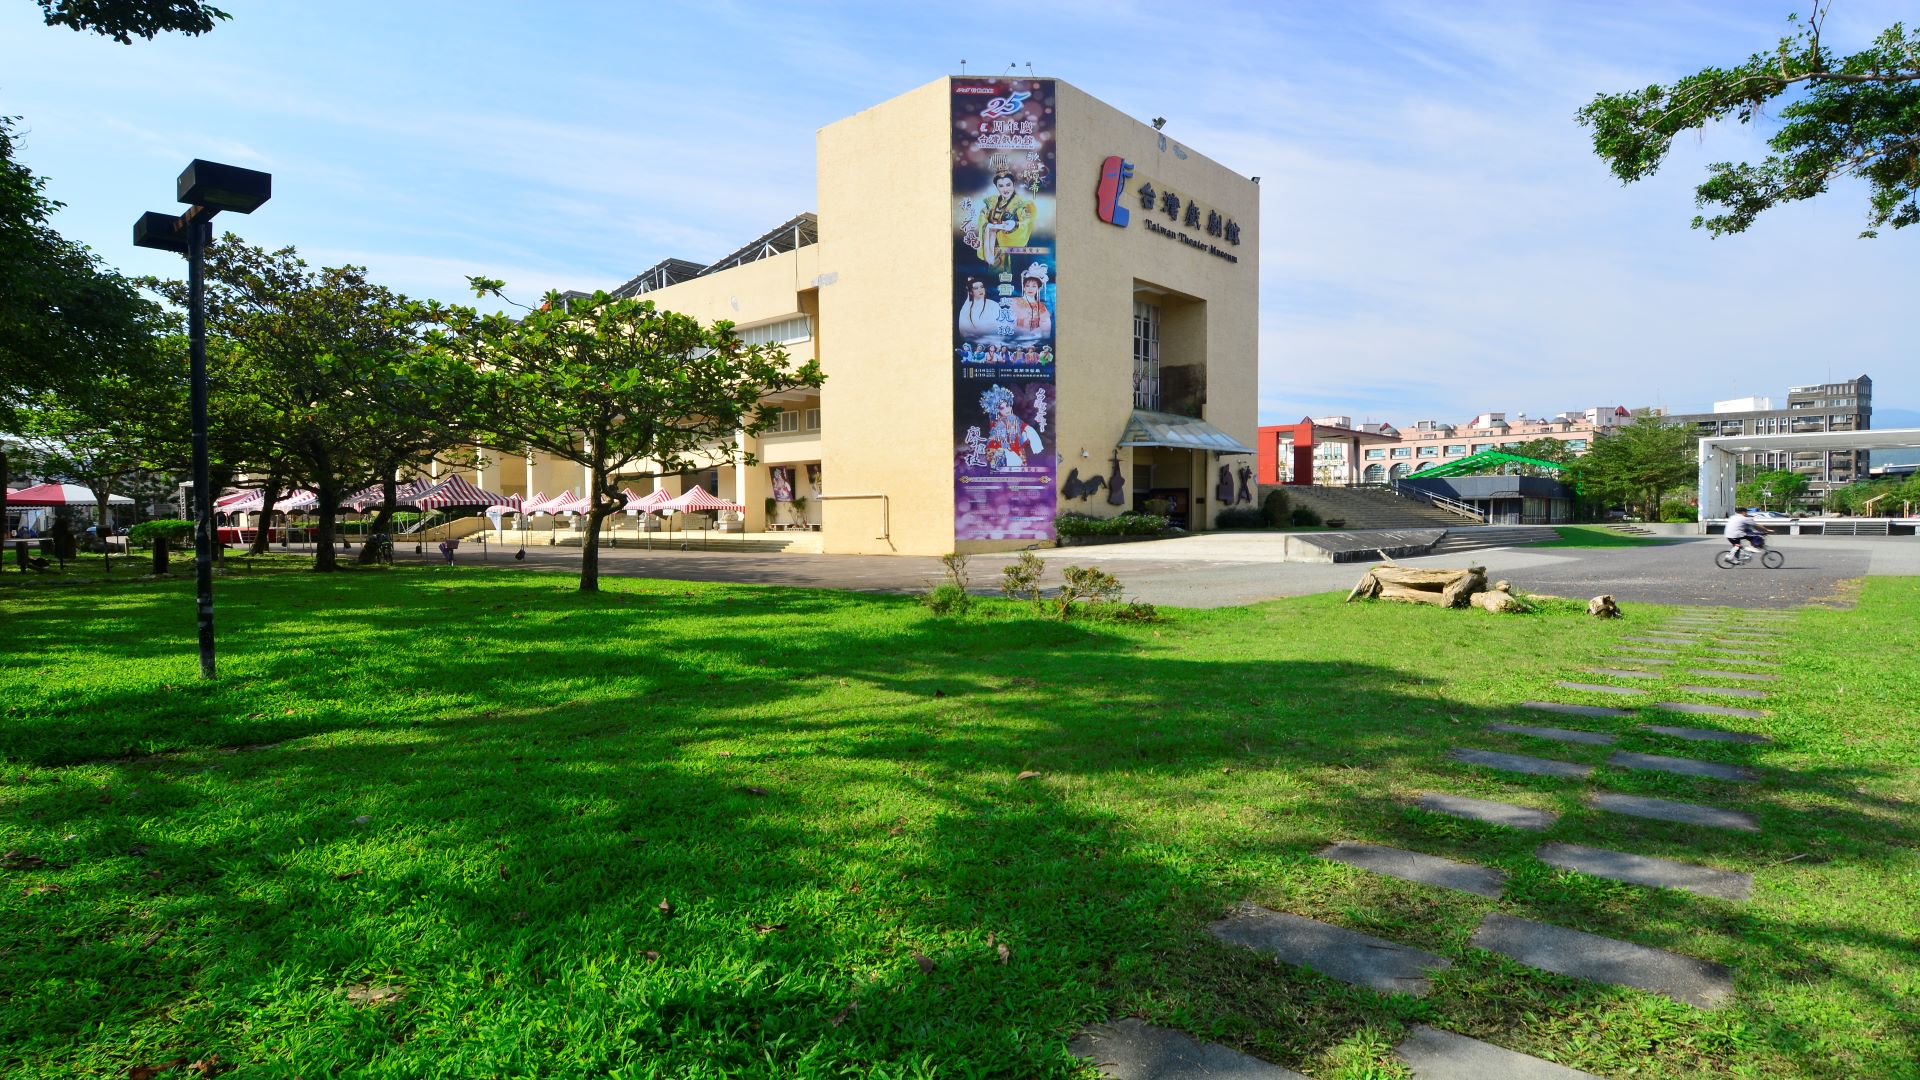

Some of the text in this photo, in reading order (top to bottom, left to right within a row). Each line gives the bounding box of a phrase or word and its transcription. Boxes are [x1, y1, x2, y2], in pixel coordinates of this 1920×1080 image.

[980, 90, 1032, 118] 25
[1138, 182, 1240, 246] 台灣戲劇館
[1144, 218, 1238, 264] Taiwan Theater Museum
